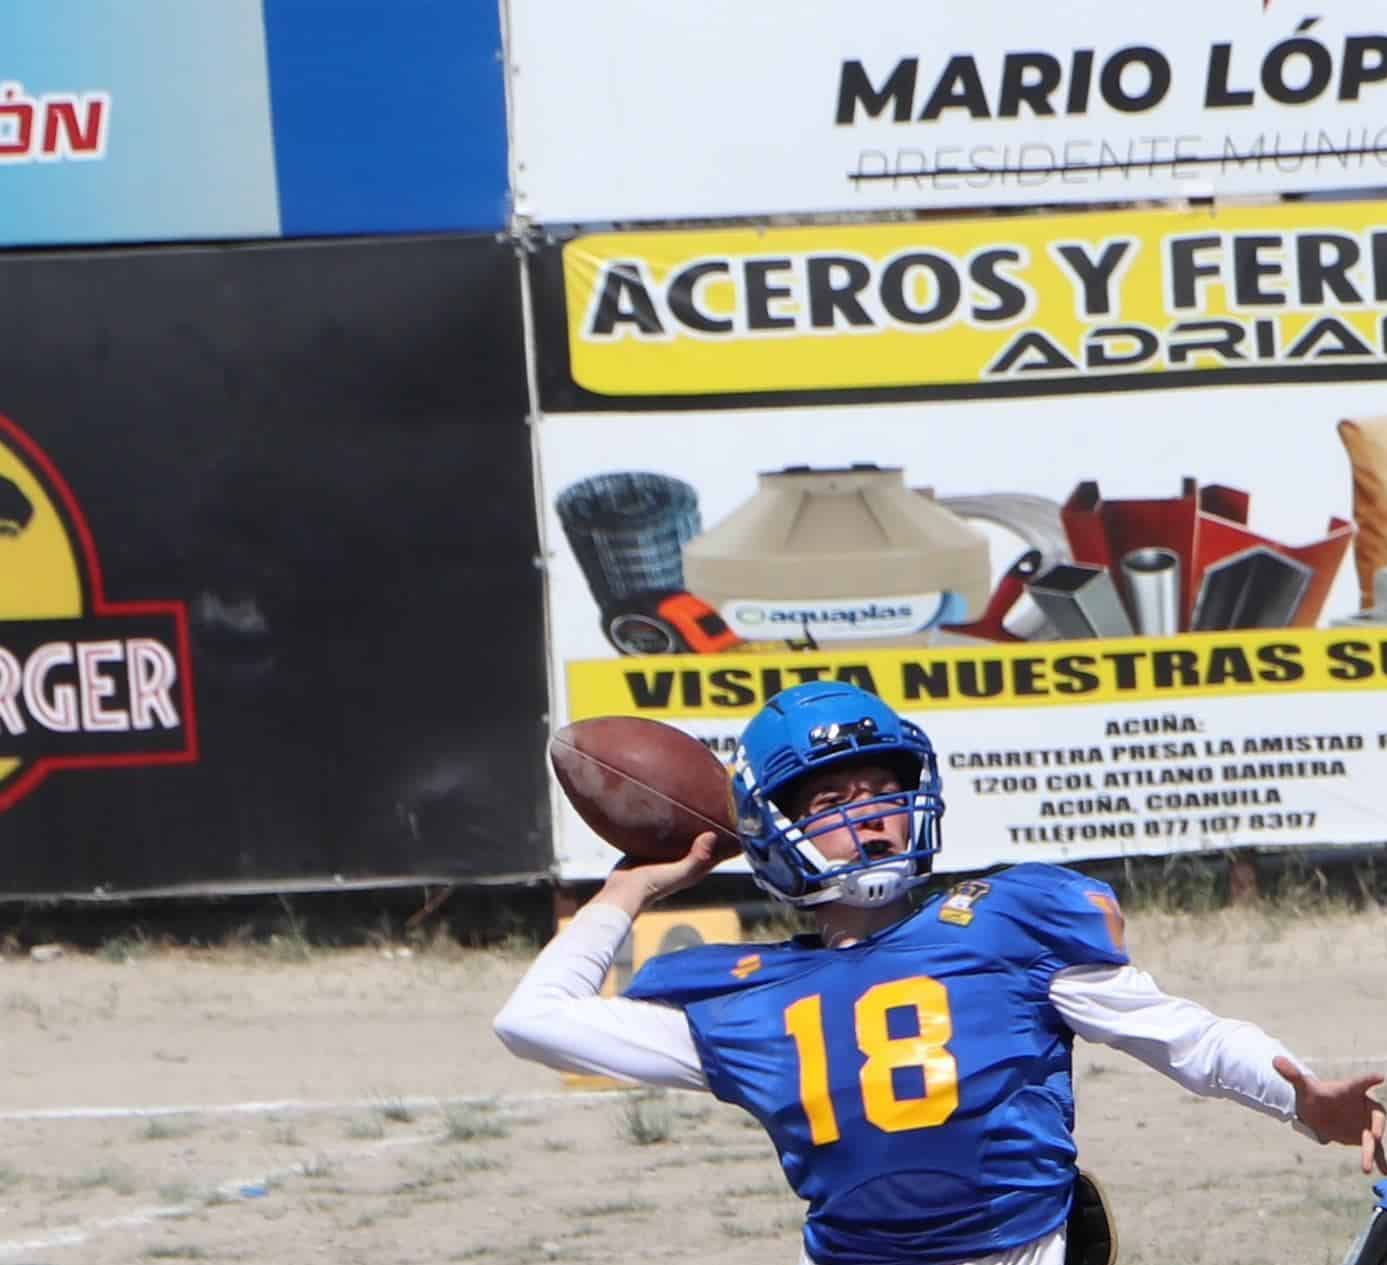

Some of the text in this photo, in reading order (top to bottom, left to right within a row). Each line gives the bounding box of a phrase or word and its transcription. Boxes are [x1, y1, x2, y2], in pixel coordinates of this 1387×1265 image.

[835, 46, 1172, 125] MARIO
[853, 133, 1206, 192] PRESIDENTE
[590, 249, 1027, 334] ACEROS
[1057, 240, 1132, 315] Y
[902, 640, 1304, 700] NUESTRAS
[949, 734, 1364, 769] CARRETERA PRESA LA AMISTAD
[973, 760, 1346, 795] 1200 COL ATILANO BARRERA
[1008, 811, 1318, 844] TELÉFONO 877 107 8397
[1146, 789, 1281, 812] COAHUILA
[784, 974, 961, 1147] 18
